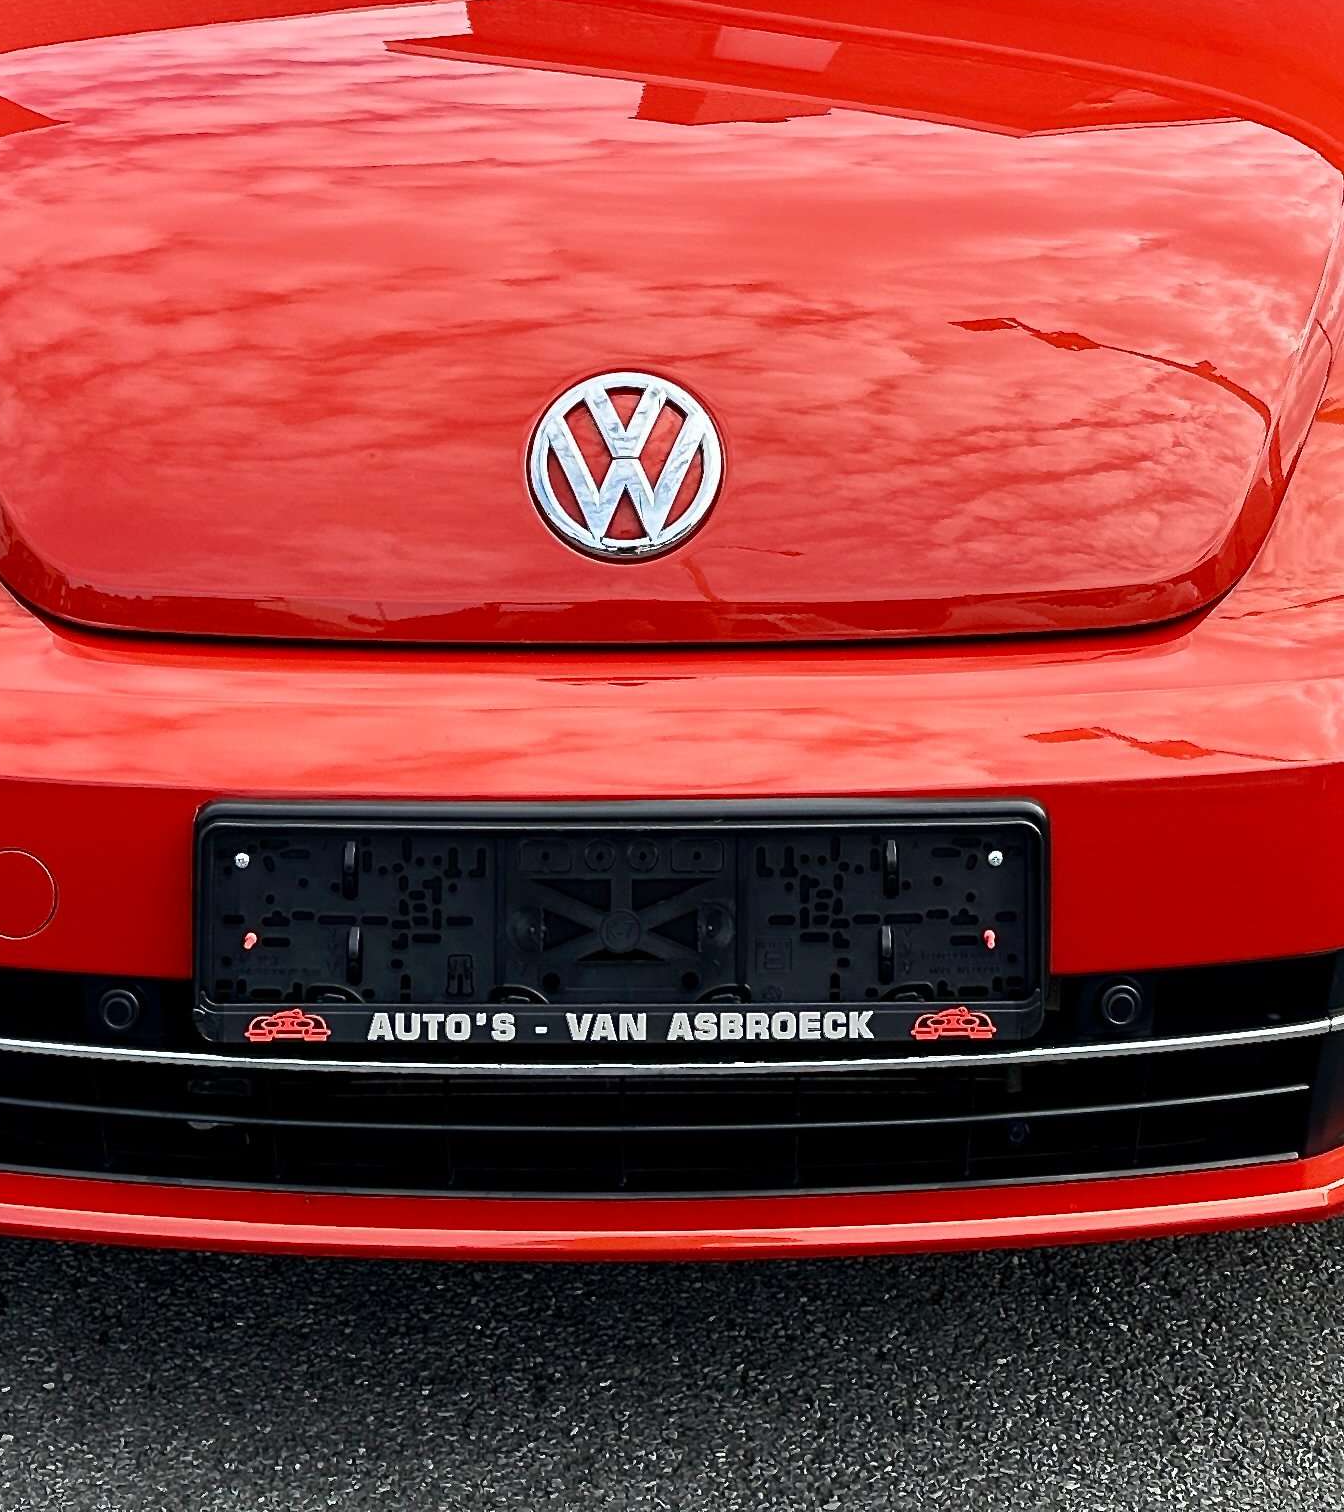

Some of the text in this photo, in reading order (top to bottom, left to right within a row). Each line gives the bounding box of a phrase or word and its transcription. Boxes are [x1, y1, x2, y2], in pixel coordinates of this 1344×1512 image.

[529, 371, 724, 555] VW
[367, 1012, 516, 1042] AUTO'S
[565, 1012, 647, 1042] VAN
[667, 1010, 875, 1041] ASBROECK
